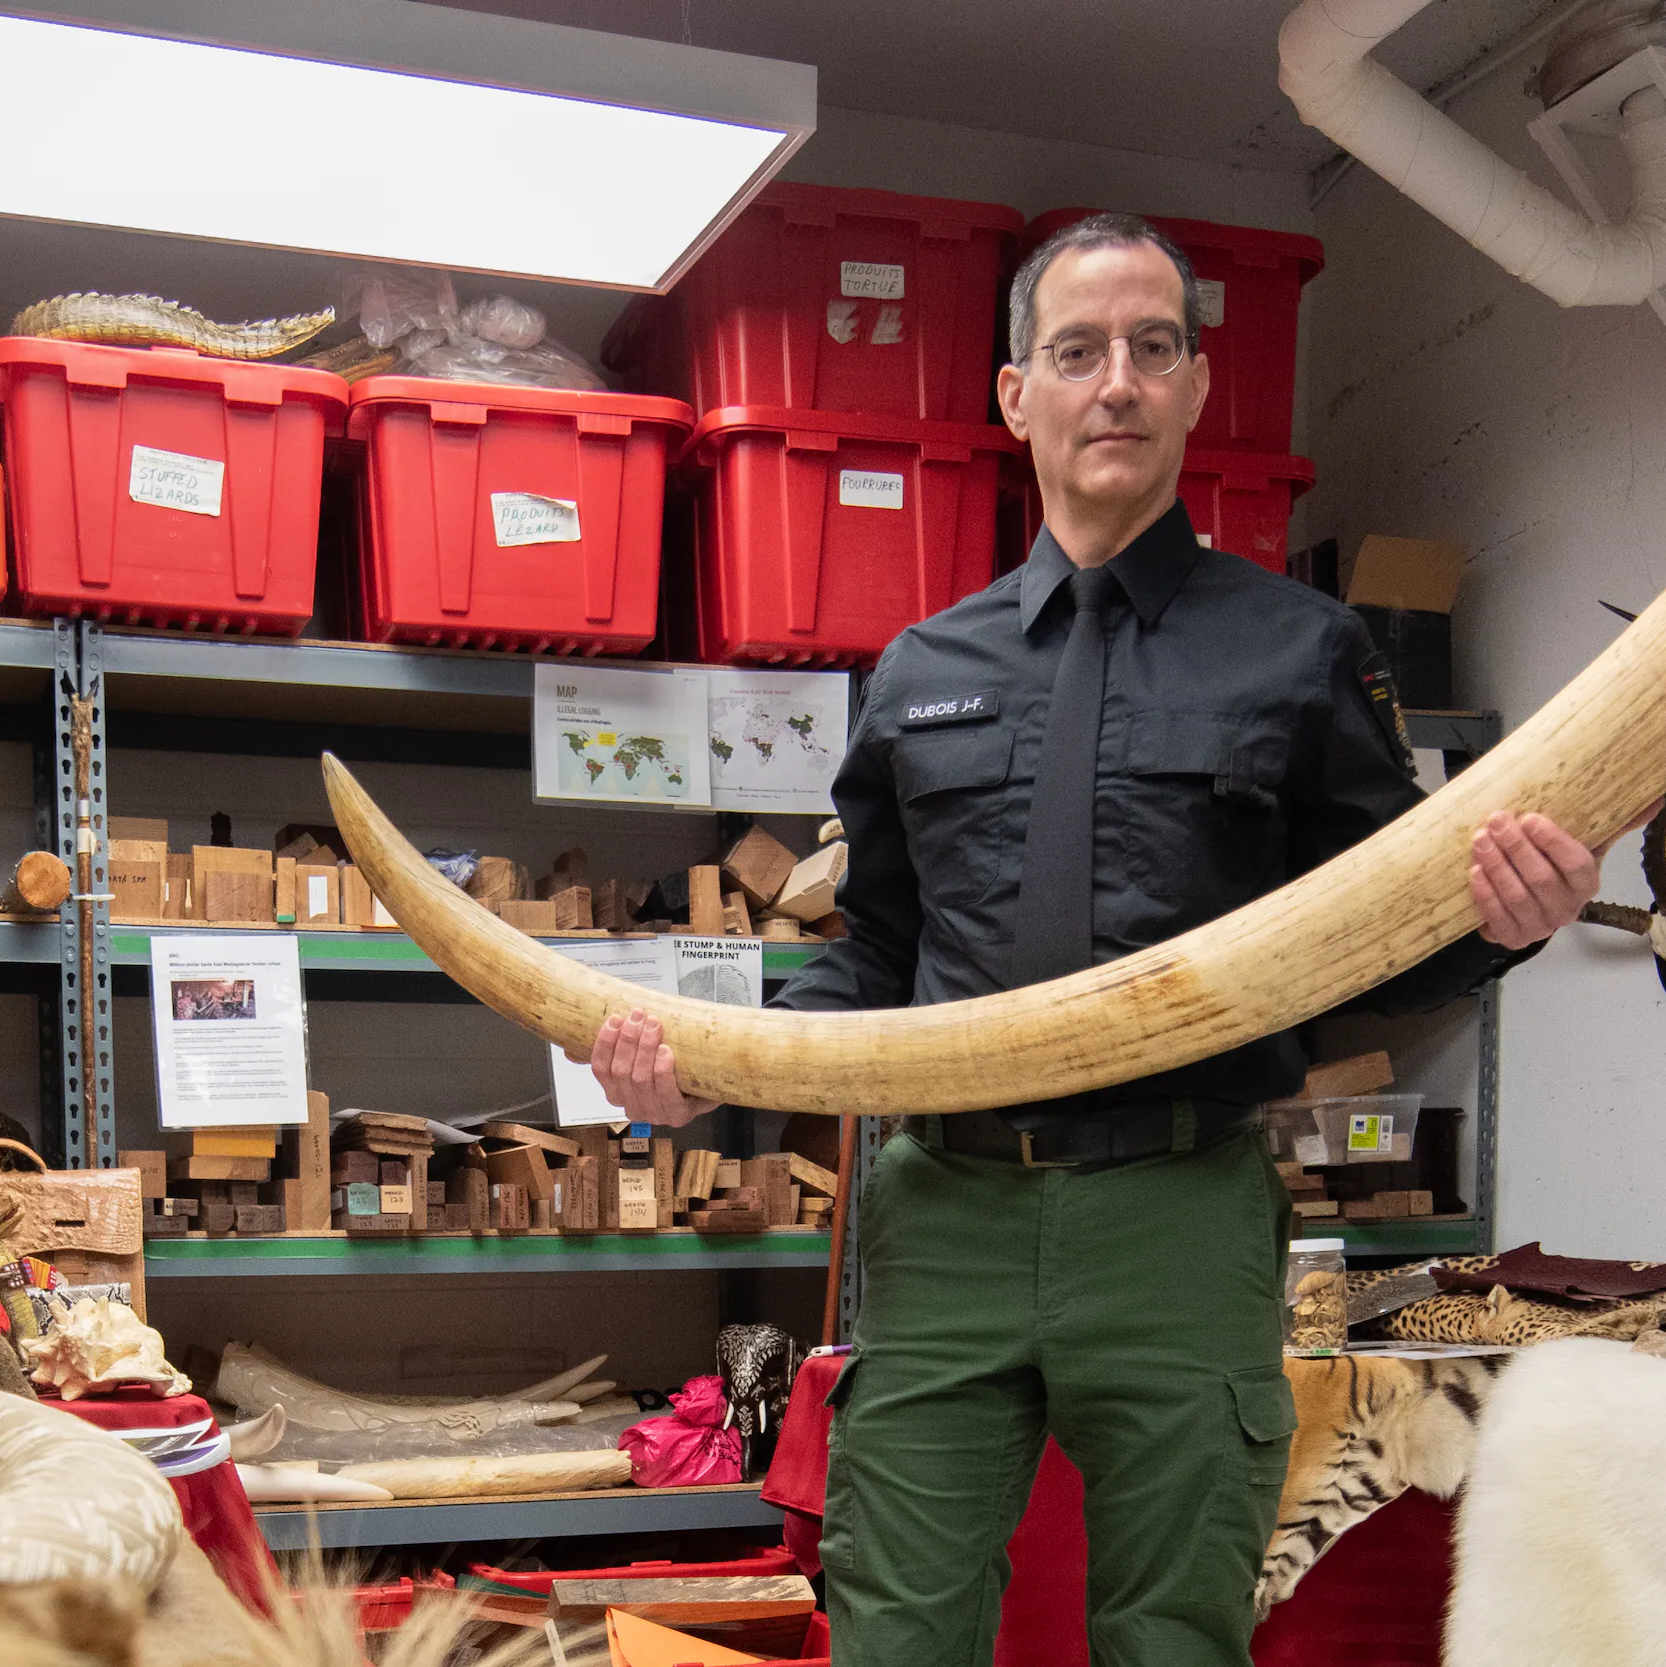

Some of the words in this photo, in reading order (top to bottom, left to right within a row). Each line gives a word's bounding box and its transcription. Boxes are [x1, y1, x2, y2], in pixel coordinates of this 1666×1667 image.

[844, 279, 899, 293] TORTUE
[139, 467, 198, 489] STUFFED
[842, 477, 901, 491] FOURRURES
[140, 483, 199, 506] LIZARDS
[556, 684, 578, 698] MAP
[908, 702, 957, 719] DUBOIS
[961, 698, 984, 712] J-F.
[684, 940, 715, 949] STUMP
[717, 941, 724, 949] &
[725, 942, 760, 951] HUMAN
[682, 951, 741, 960] FINGERPRINT
[629, 1184, 643, 1193] 145
[390, 1196, 404, 1204] 123
